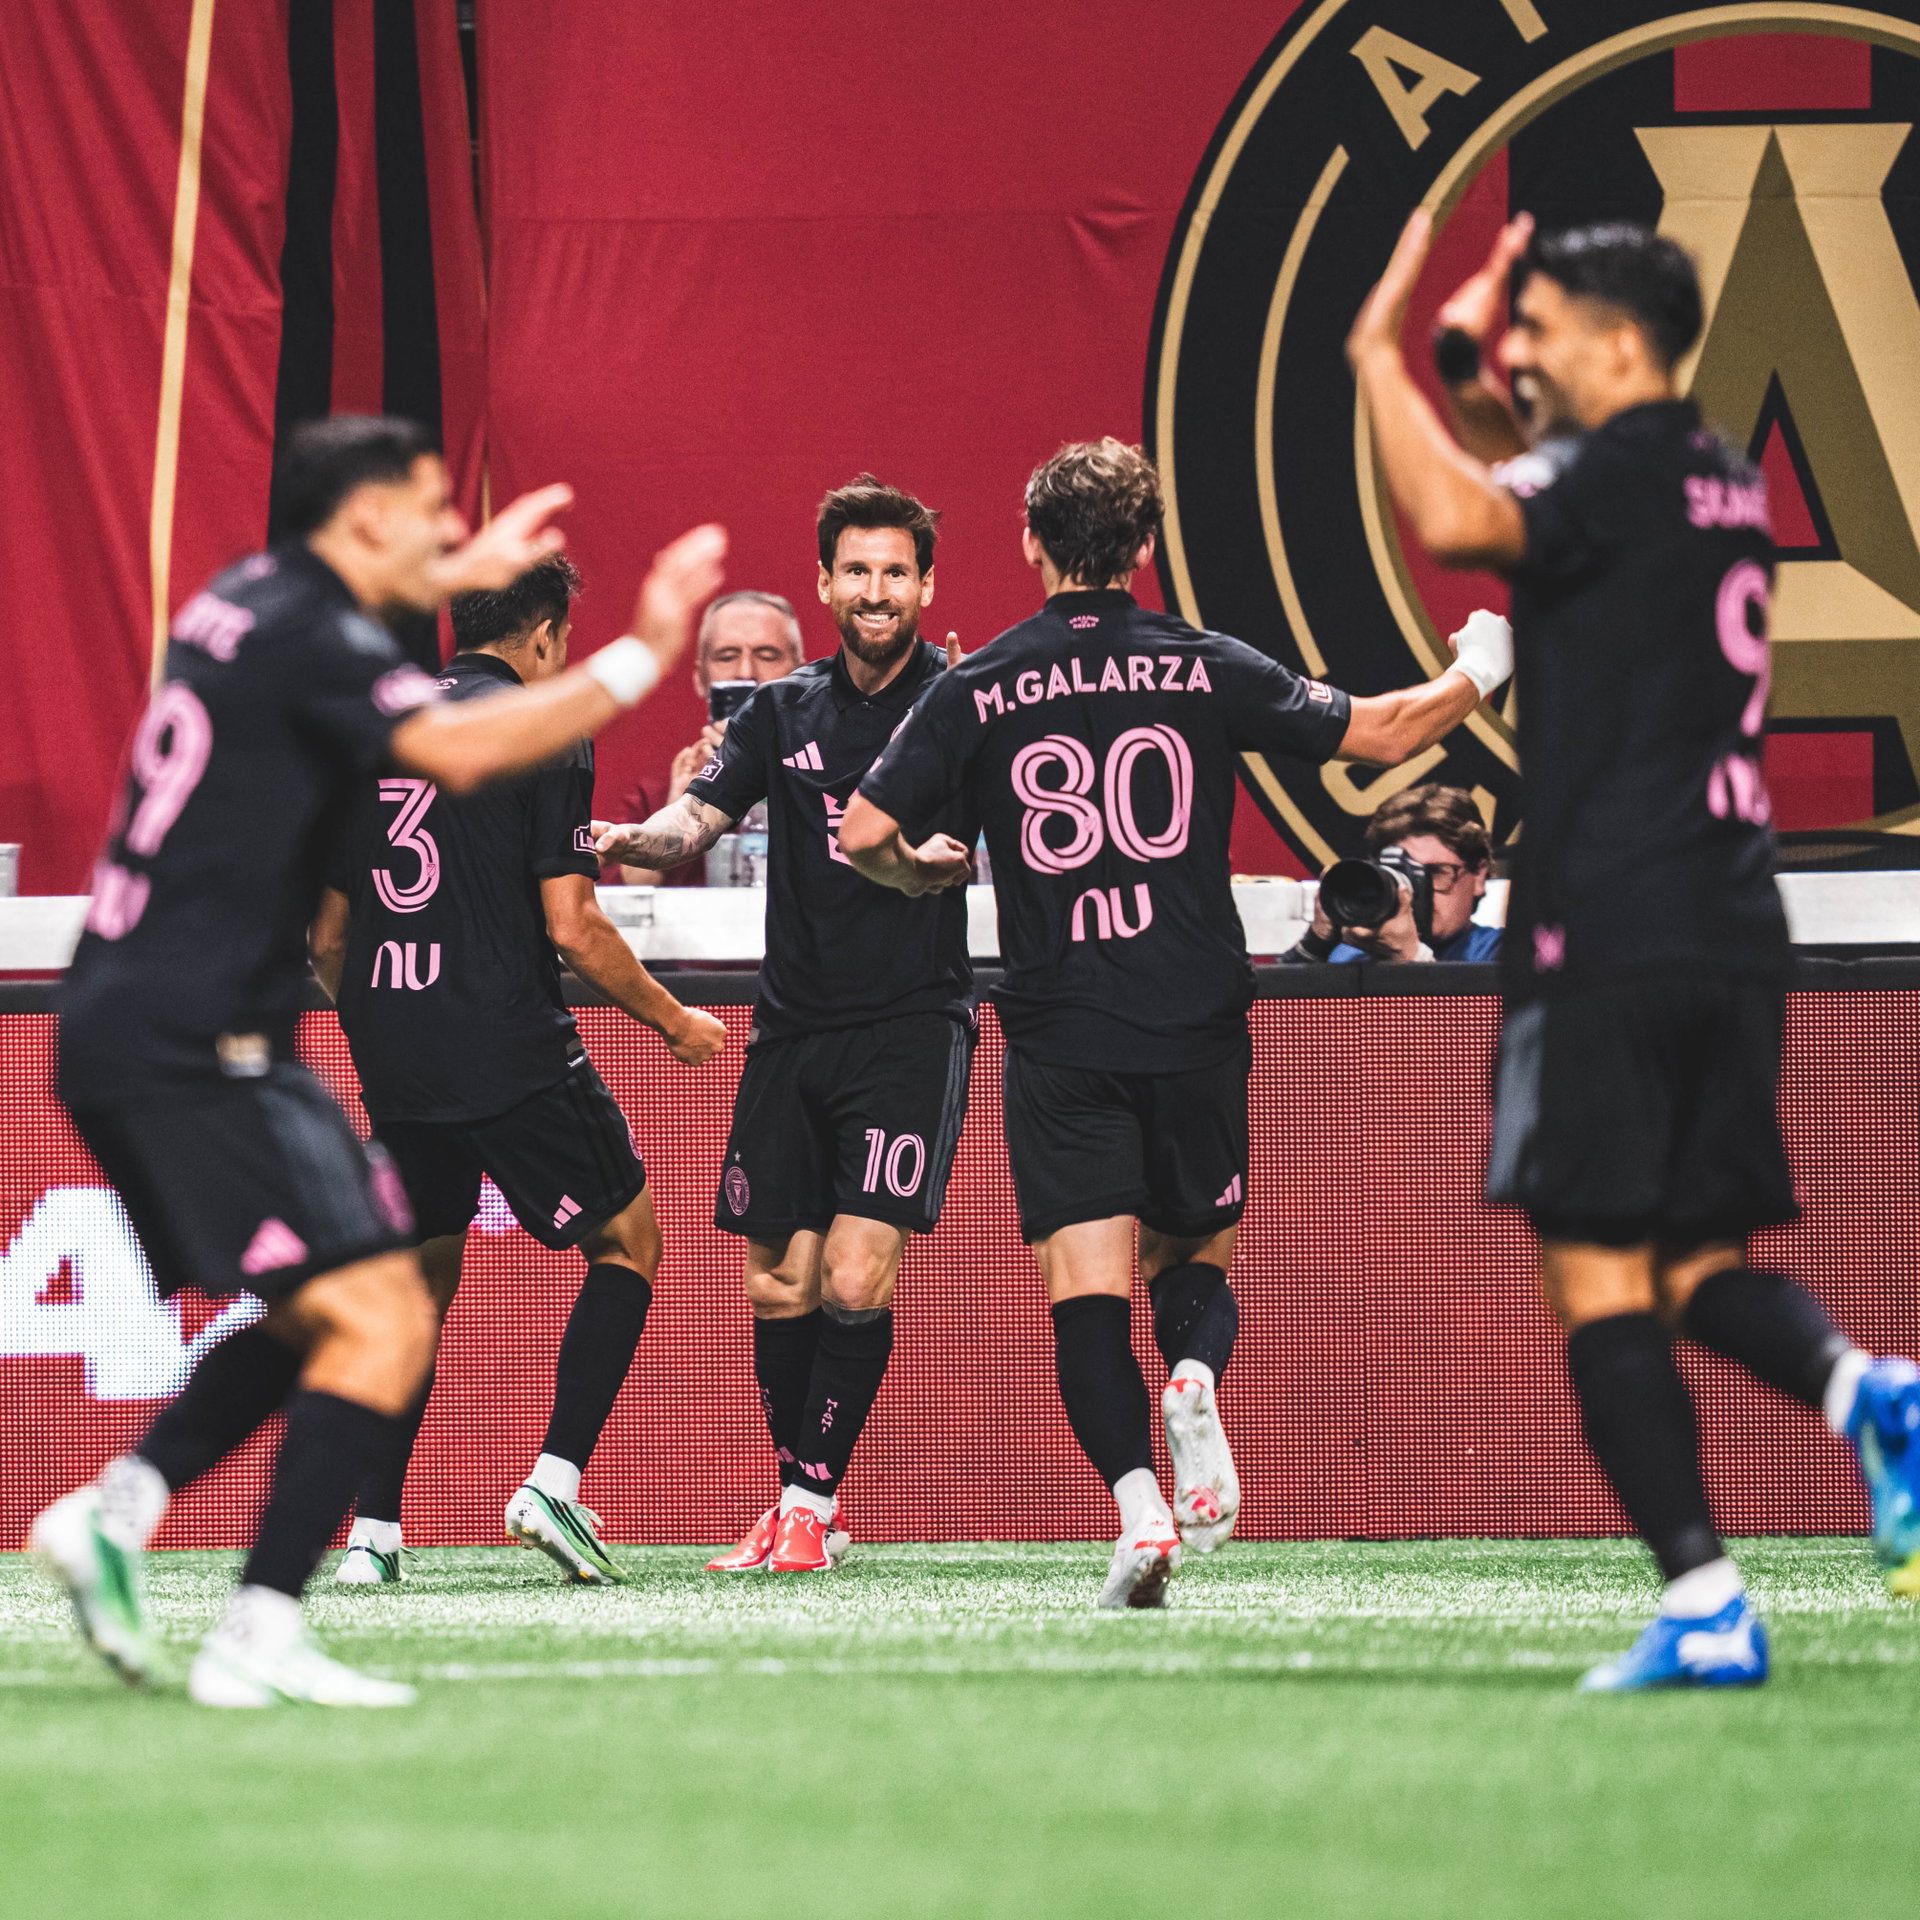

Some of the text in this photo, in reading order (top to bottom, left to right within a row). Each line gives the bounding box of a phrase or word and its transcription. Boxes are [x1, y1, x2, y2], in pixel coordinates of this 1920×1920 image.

[973, 655, 1212, 724] M.GALARZA
[1716, 558, 1770, 738] 9
[129, 681, 213, 856] 9
[1011, 723, 1194, 875] 80
[371, 777, 441, 914] 3
[862, 1127, 926, 1198] 10
